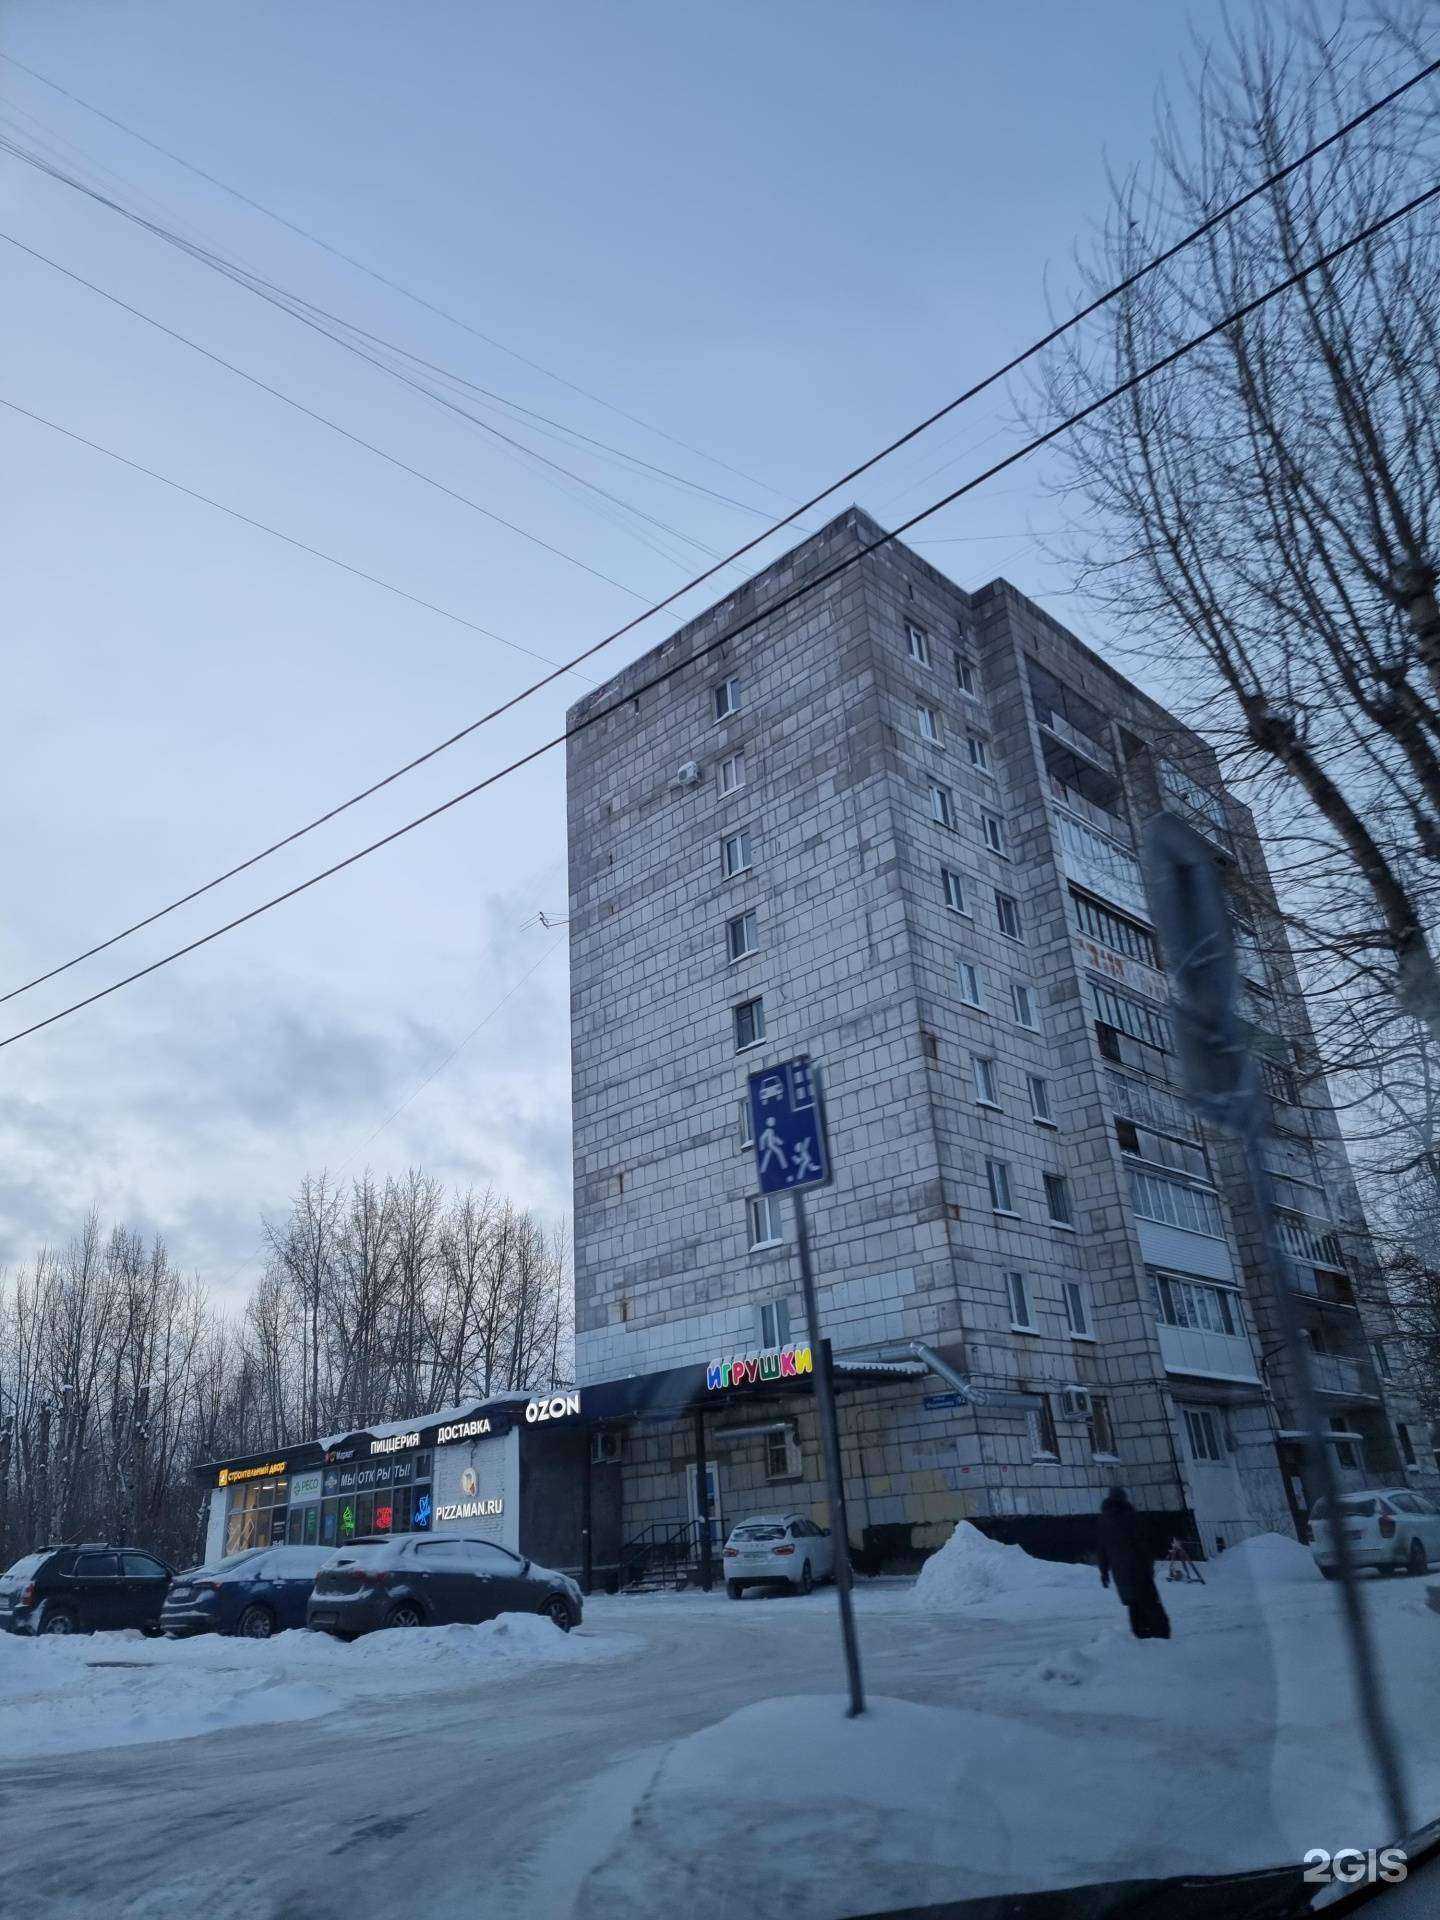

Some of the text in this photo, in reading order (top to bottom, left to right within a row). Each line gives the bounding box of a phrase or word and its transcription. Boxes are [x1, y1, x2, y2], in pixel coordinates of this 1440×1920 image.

[707, 1347, 812, 1390] ИГРУШКИ
[525, 1394, 580, 1423] OZON
[370, 1418, 490, 1454] ПИЦЦЕРИЯ ДОСТАВКА
[302, 1478, 319, 1491] РЕСО
[340, 1472, 356, 1486] МЫ
[435, 1500, 503, 1520] PIZZAMAN.RU
